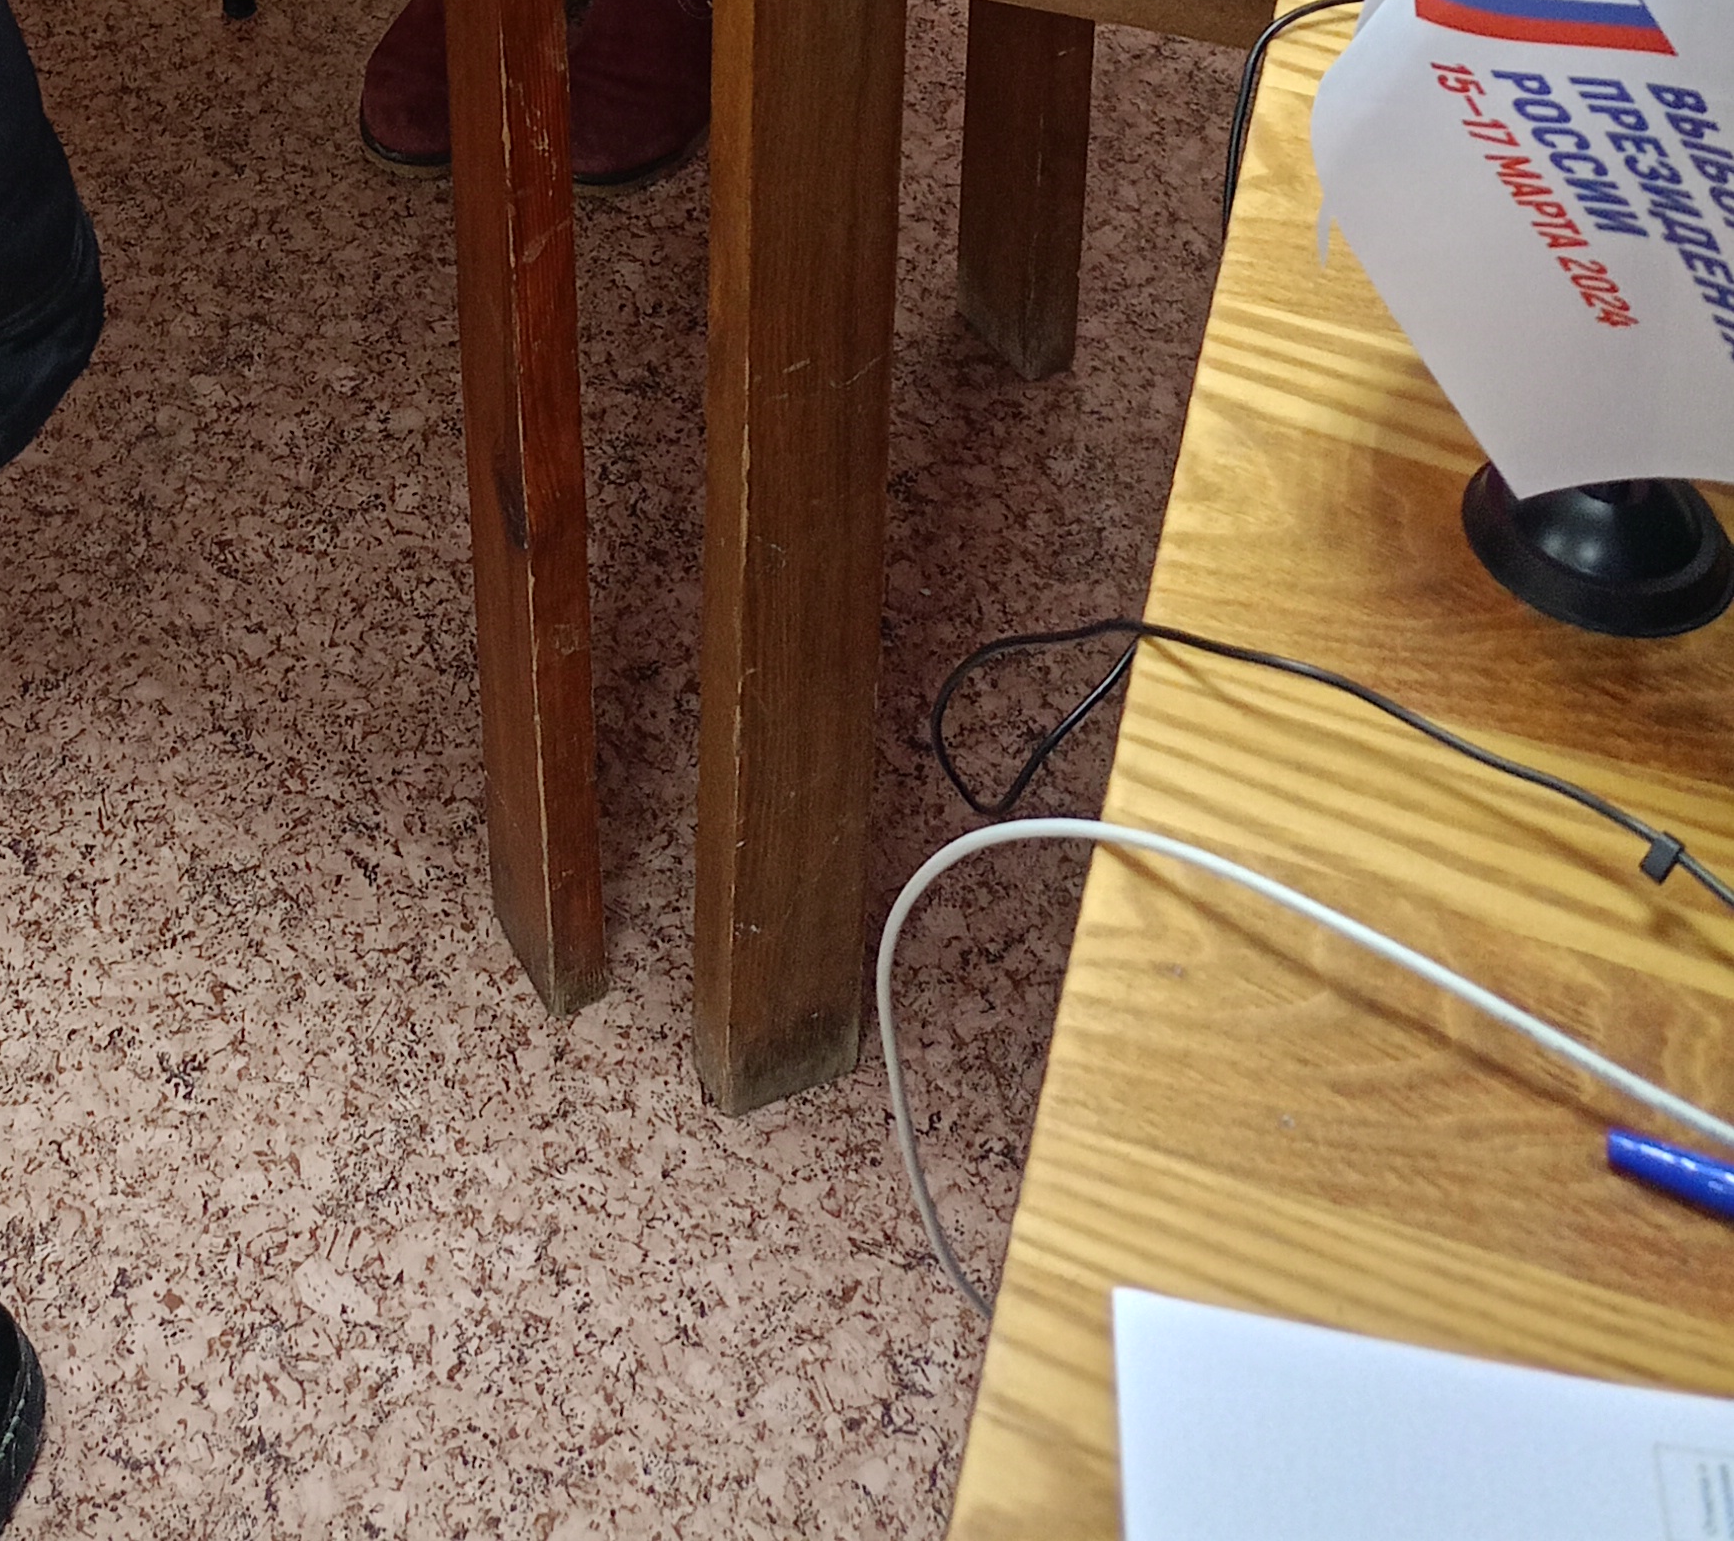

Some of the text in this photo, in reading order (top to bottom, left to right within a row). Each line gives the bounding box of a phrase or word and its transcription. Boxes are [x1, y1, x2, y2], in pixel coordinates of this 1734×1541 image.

[1430, 62, 1639, 327] 15–17 МАРТА 2024
[1491, 69, 1649, 238] РОССИИ
[1568, 77, 1734, 360] ПРЕЗИДЕН
[1646, 82, 1734, 229] ВЫБ
